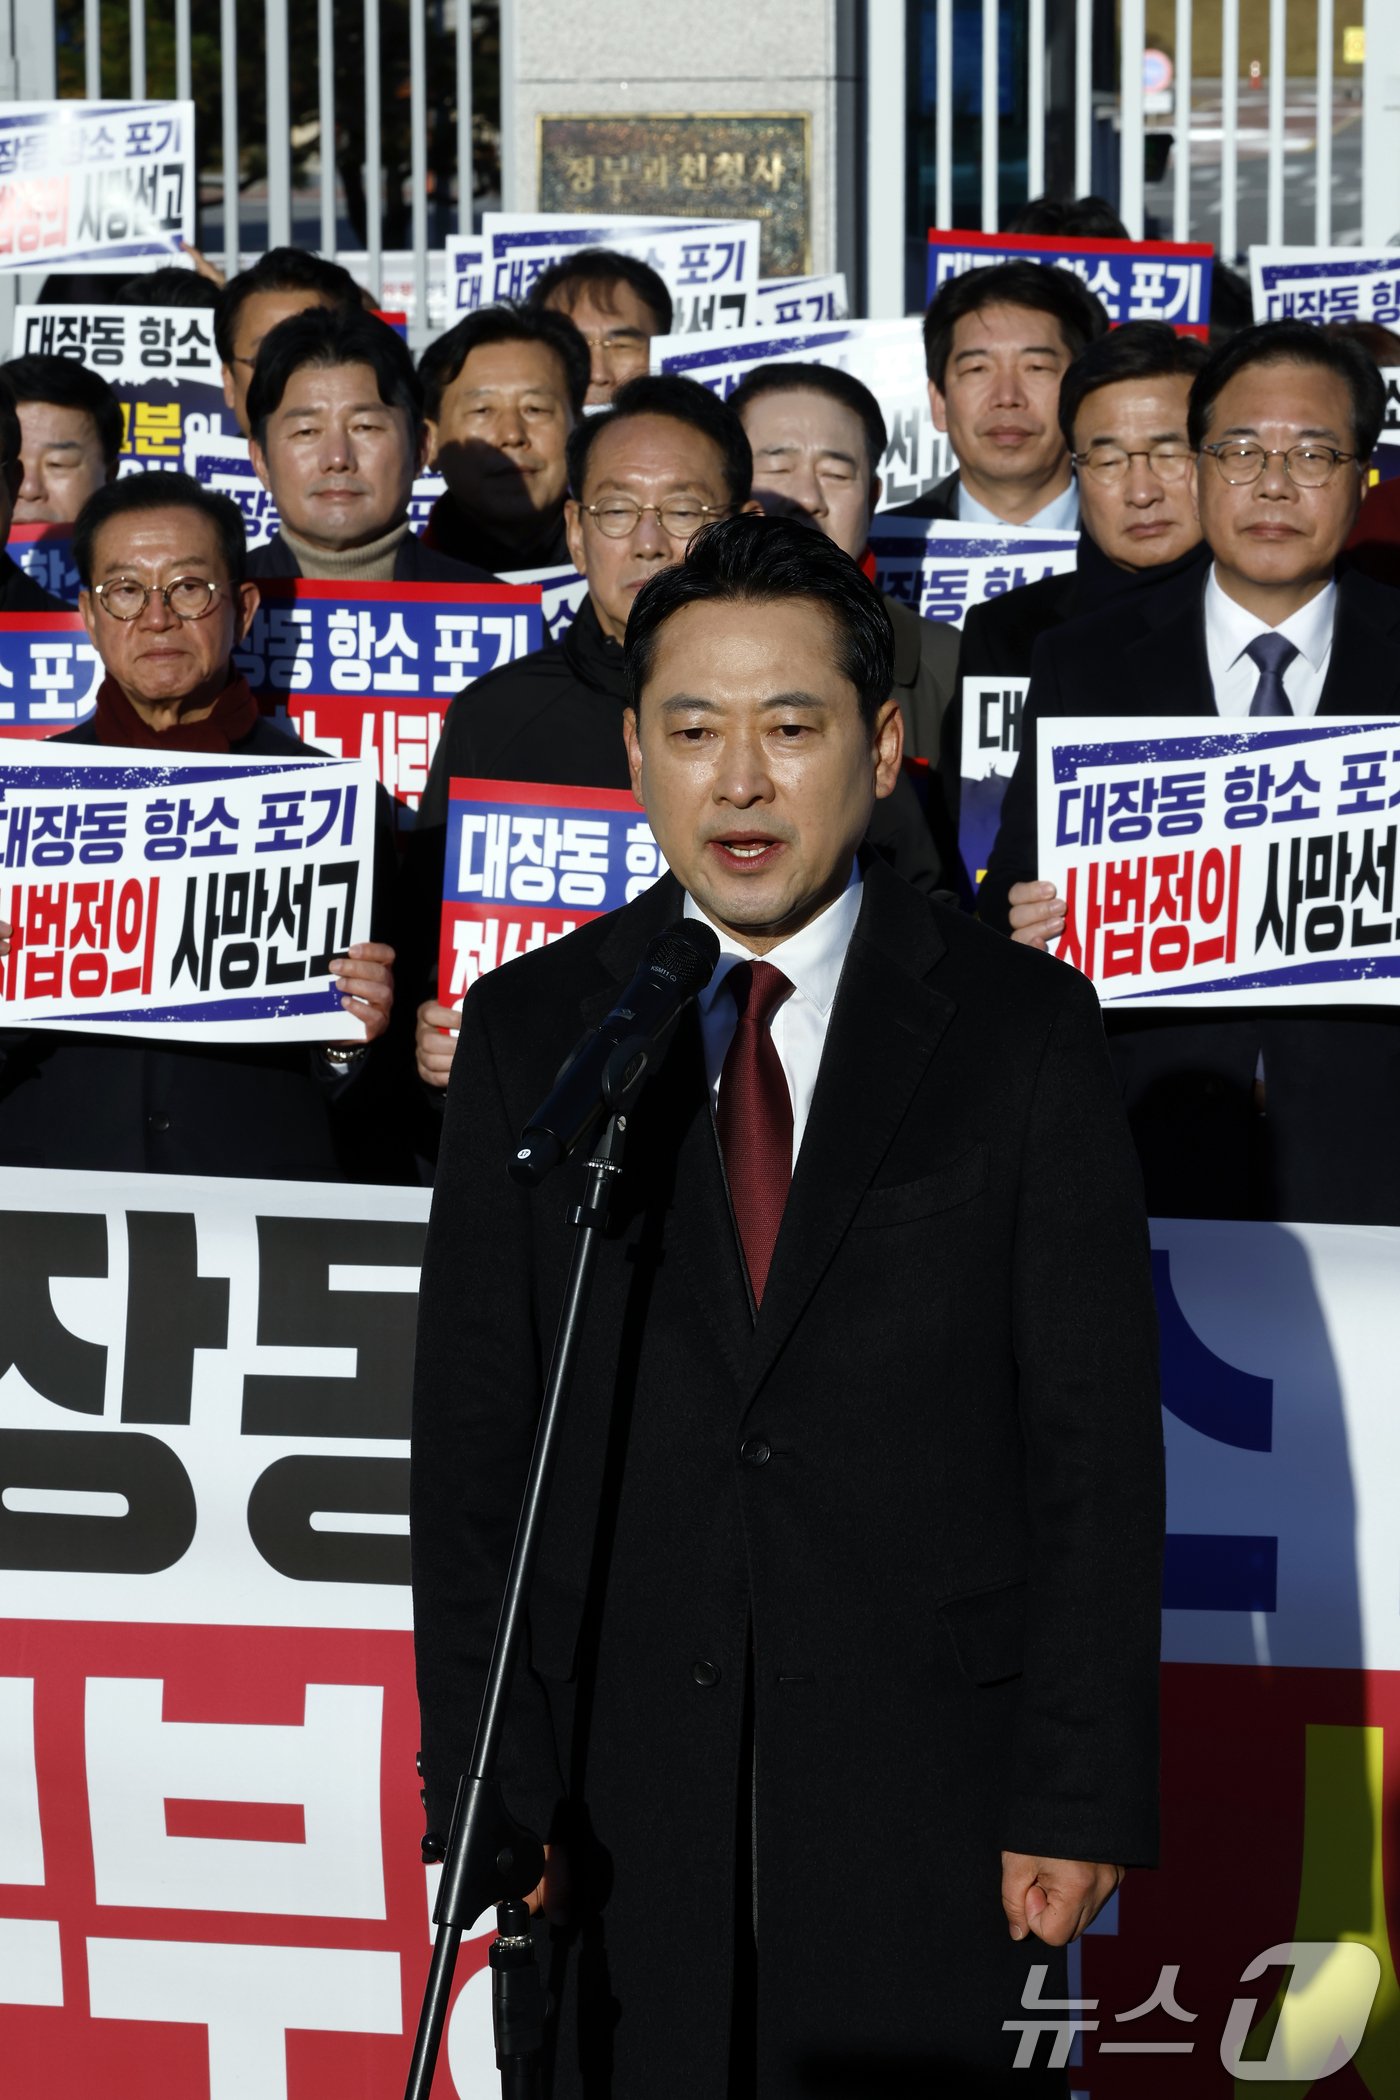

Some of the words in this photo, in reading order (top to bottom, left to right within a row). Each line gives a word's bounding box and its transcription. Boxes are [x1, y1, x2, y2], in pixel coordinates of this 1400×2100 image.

[125, 118, 183, 158] 포기
[565, 152, 786, 195] 정부과천청사
[675, 240, 747, 286] 포기
[1128, 262, 1202, 323] 포기
[25, 315, 125, 367] 대장동
[139, 316, 212, 368] 항소
[328, 608, 420, 692] 항소
[433, 614, 528, 693] 포기
[0, 802, 128, 868] 대장동
[144, 796, 240, 862] 항소
[255, 785, 358, 853] 포기
[1056, 771, 1206, 847] 대장동
[1224, 759, 1321, 829] 항소
[1337, 750, 1400, 816] 포
[457, 813, 610, 906] 대장동
[170, 860, 360, 993] 사망선고
[1055, 844, 1242, 982] 사법정의
[1255, 824, 1400, 957] 사망선
